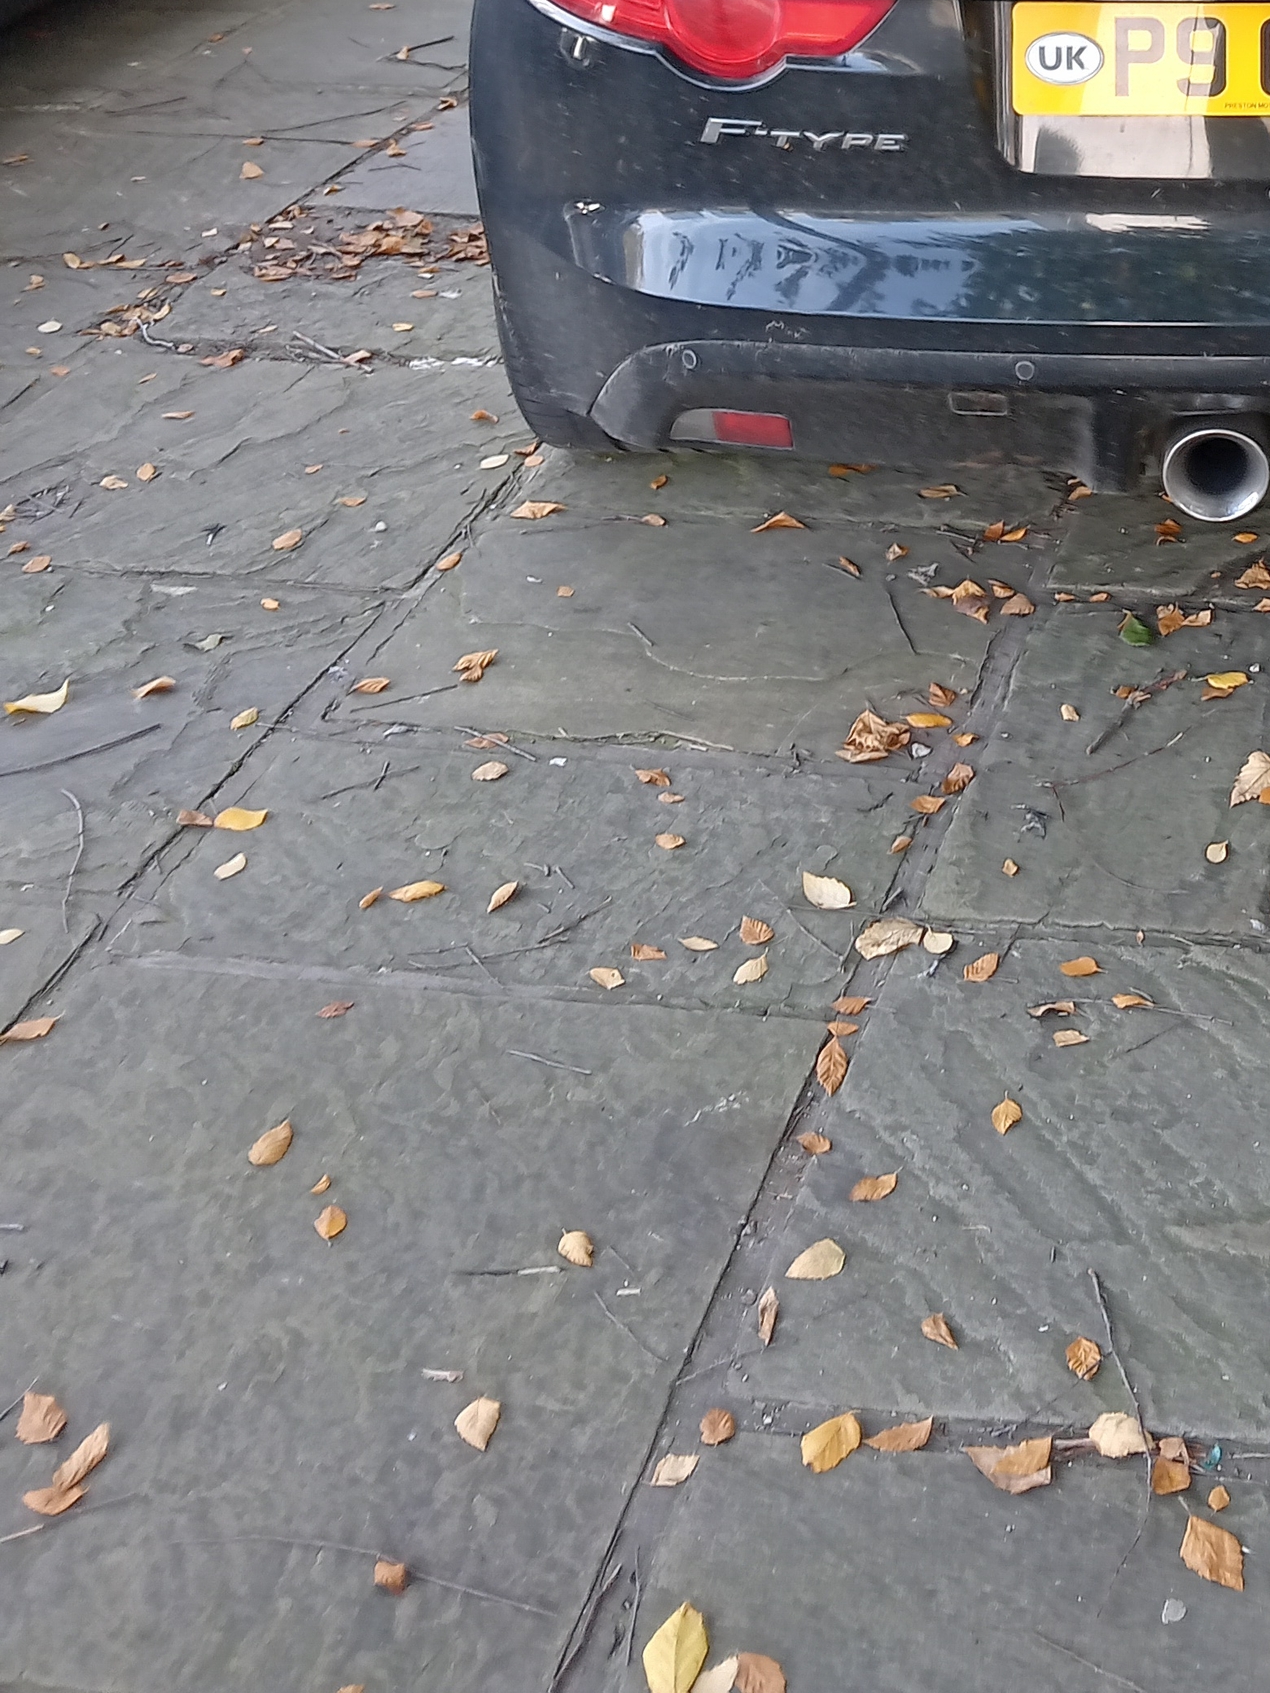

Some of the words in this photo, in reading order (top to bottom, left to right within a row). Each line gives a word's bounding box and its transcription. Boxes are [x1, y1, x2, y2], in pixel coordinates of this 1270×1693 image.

[1038, 45, 1087, 71] UK
[1114, 16, 1227, 97] P9
[700, 117, 907, 150] F-TYPE
